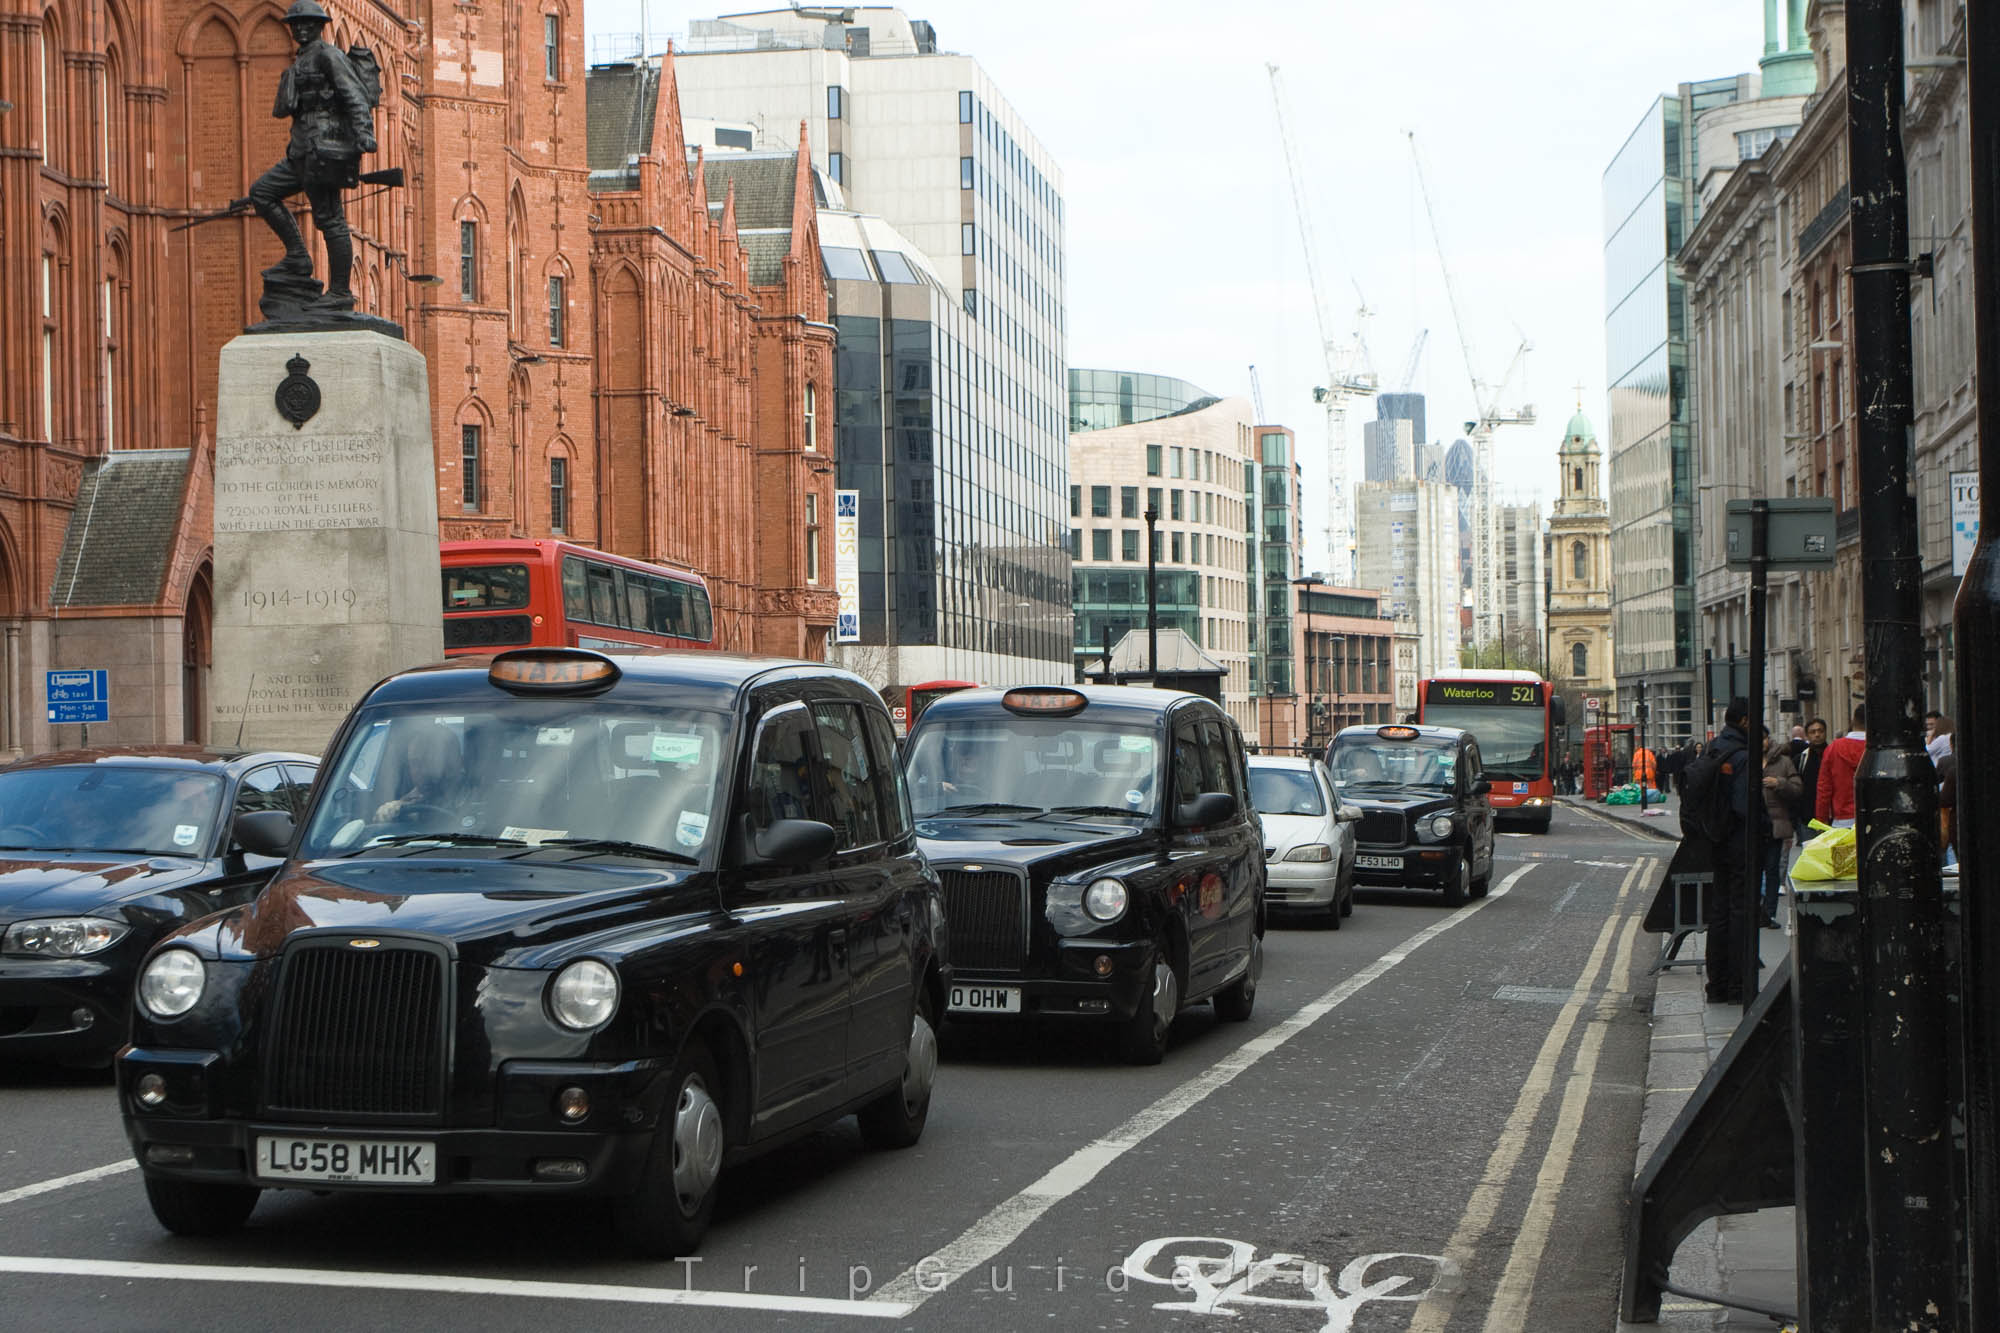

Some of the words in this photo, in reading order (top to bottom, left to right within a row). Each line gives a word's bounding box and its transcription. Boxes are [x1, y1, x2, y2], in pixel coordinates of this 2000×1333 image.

[224, 443, 249, 454] THE
[255, 441, 298, 453] ROYAL
[303, 439, 371, 452] FUSILIERS
[249, 456, 260, 465] OF
[267, 454, 314, 465] LONDON
[222, 483, 238, 493] TO
[239, 482, 262, 492] THE
[265, 480, 325, 492] GLORIOUS
[328, 479, 378, 490] MEMORY
[278, 493, 290, 502] OF
[299, 493, 320, 502] THE
[274, 504, 312, 516] ROYAL
[314, 502, 373, 514] FUSILIERS
[219, 520, 247, 531] WHO
[250, 519, 276, 530] FELL
[278, 519, 291, 529] IN
[293, 518, 316, 529] THE
[318, 517, 352, 528] GREAT
[356, 516, 379, 527] WAR
[838, 521, 856, 555] ISIS
[243, 588, 357, 610] 1914-1919
[839, 578, 856, 611] ISIS
[514, 662, 584, 681] TAXI
[268, 674, 292, 685] AND
[297, 674, 312, 684] TO
[315, 674, 336, 684] THE
[252, 688, 288, 699] ROYAL
[291, 687, 350, 699] FUSILIERS
[1443, 687, 1494, 698] Waterloo
[1511, 686, 1534, 702] 521
[82, 703, 96, 711] Sat
[215, 704, 244, 714] WHO
[249, 704, 272, 714] FELL
[277, 703, 289, 713] IN
[294, 703, 314, 713] THE
[270, 1140, 350, 1173] LG58
[359, 1144, 423, 1176] MHK
